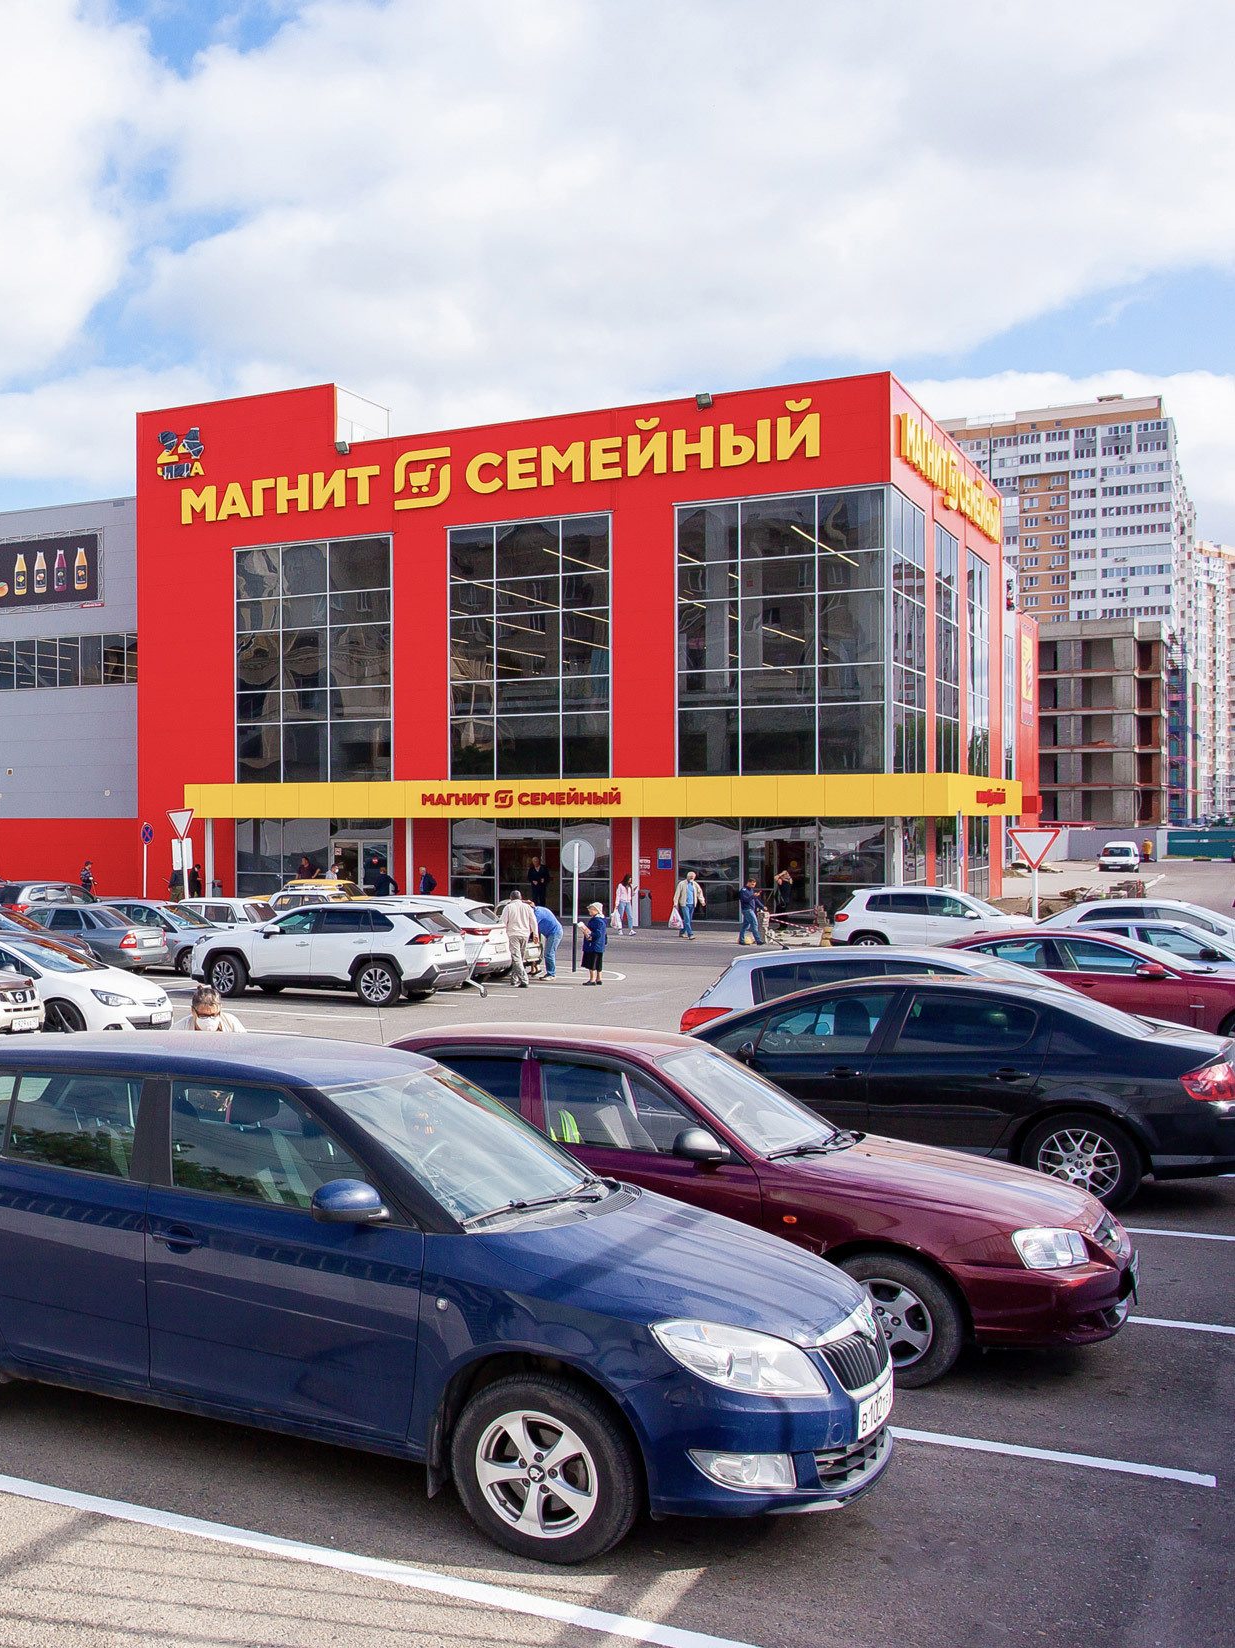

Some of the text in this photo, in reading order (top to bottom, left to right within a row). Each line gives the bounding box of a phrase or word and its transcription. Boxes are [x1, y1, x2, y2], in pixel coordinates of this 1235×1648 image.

[181, 397, 820, 524] МАГНИТ СЕМЕЙНЫЙ
[422, 787, 621, 806] МАГНИТ СЕМЕЙНЫЙ
